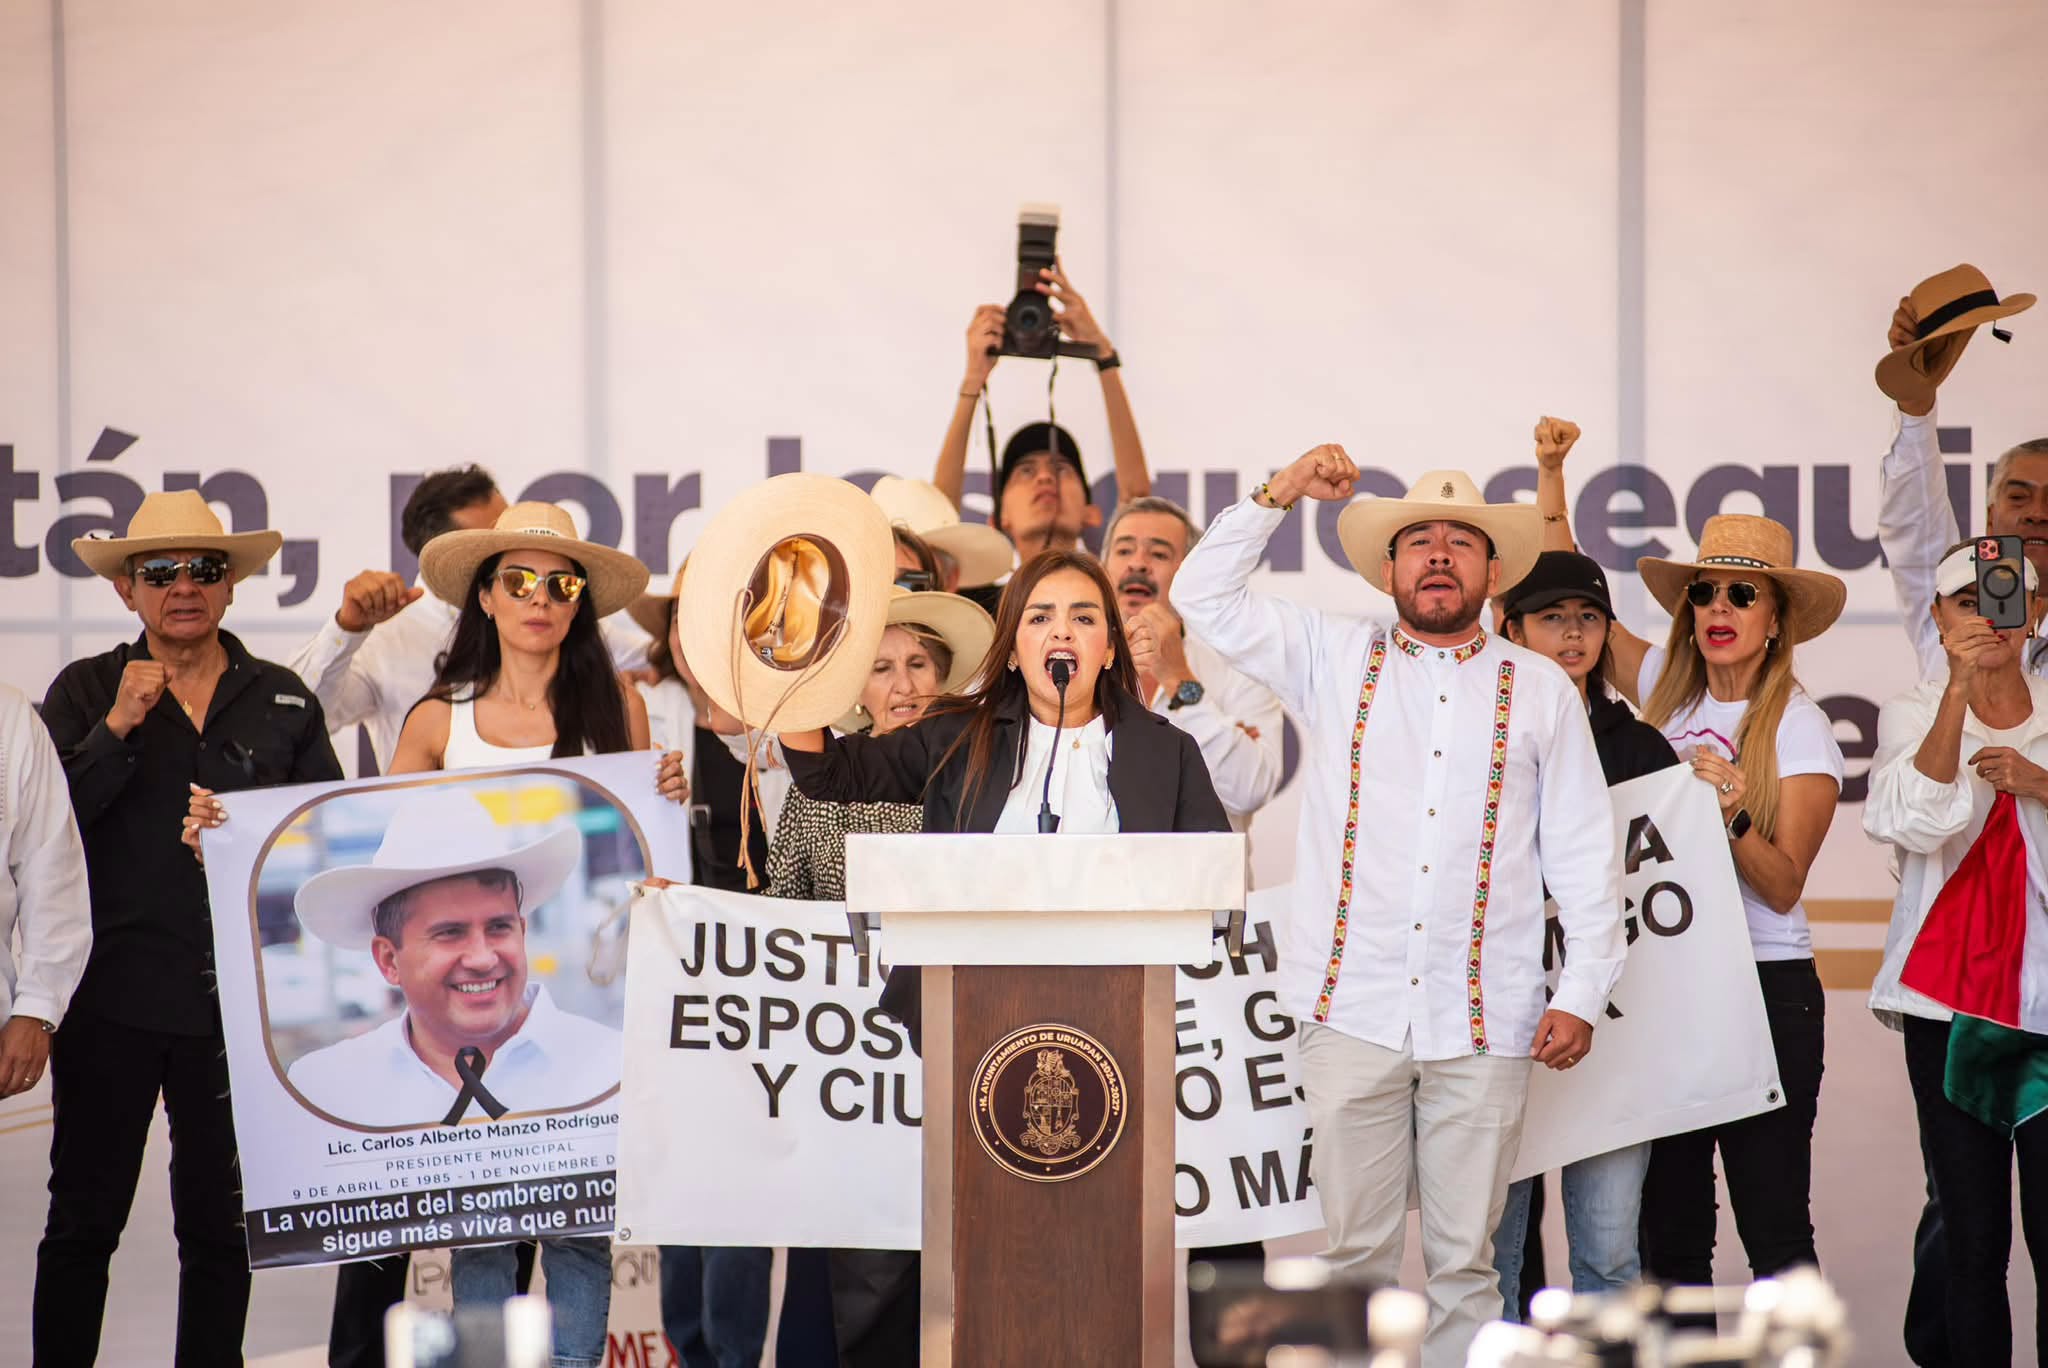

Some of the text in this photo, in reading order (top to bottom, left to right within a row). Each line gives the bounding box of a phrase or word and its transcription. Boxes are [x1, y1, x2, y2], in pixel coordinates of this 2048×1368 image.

[680, 922, 890, 988] JUSTI
[751, 1063, 799, 1118] Y
[1245, 1053, 1306, 1112] E
[981, 1034, 1038, 1094] AYUNTAMIENTO
[1039, 1032, 1054, 1041] DE
[1056, 1033, 1103, 1062] URUAPAN
[328, 1141, 357, 1156] Lic.
[362, 1135, 415, 1152] Carlos
[420, 1128, 482, 1146] Alberto
[487, 1122, 541, 1139] Manzo
[385, 1141, 576, 1172] PRESIDENTE MUNICIPAL
[292, 1189, 301, 1200] 9
[309, 1185, 330, 1199] DE
[336, 1181, 383, 1195] ABRIL
[390, 1176, 410, 1189] DE
[417, 1173, 451, 1186] 1985
[470, 1170, 476, 1180] 1
[483, 1167, 502, 1179] DE
[510, 1158, 599, 1175] NOVIEMBRE
[263, 1177, 616, 1234] La voluntad del sombrero no
[322, 1228, 393, 1256] sigue
[400, 1218, 454, 1245] más
[461, 1214, 513, 1237] viva
[520, 1208, 567, 1236] que
